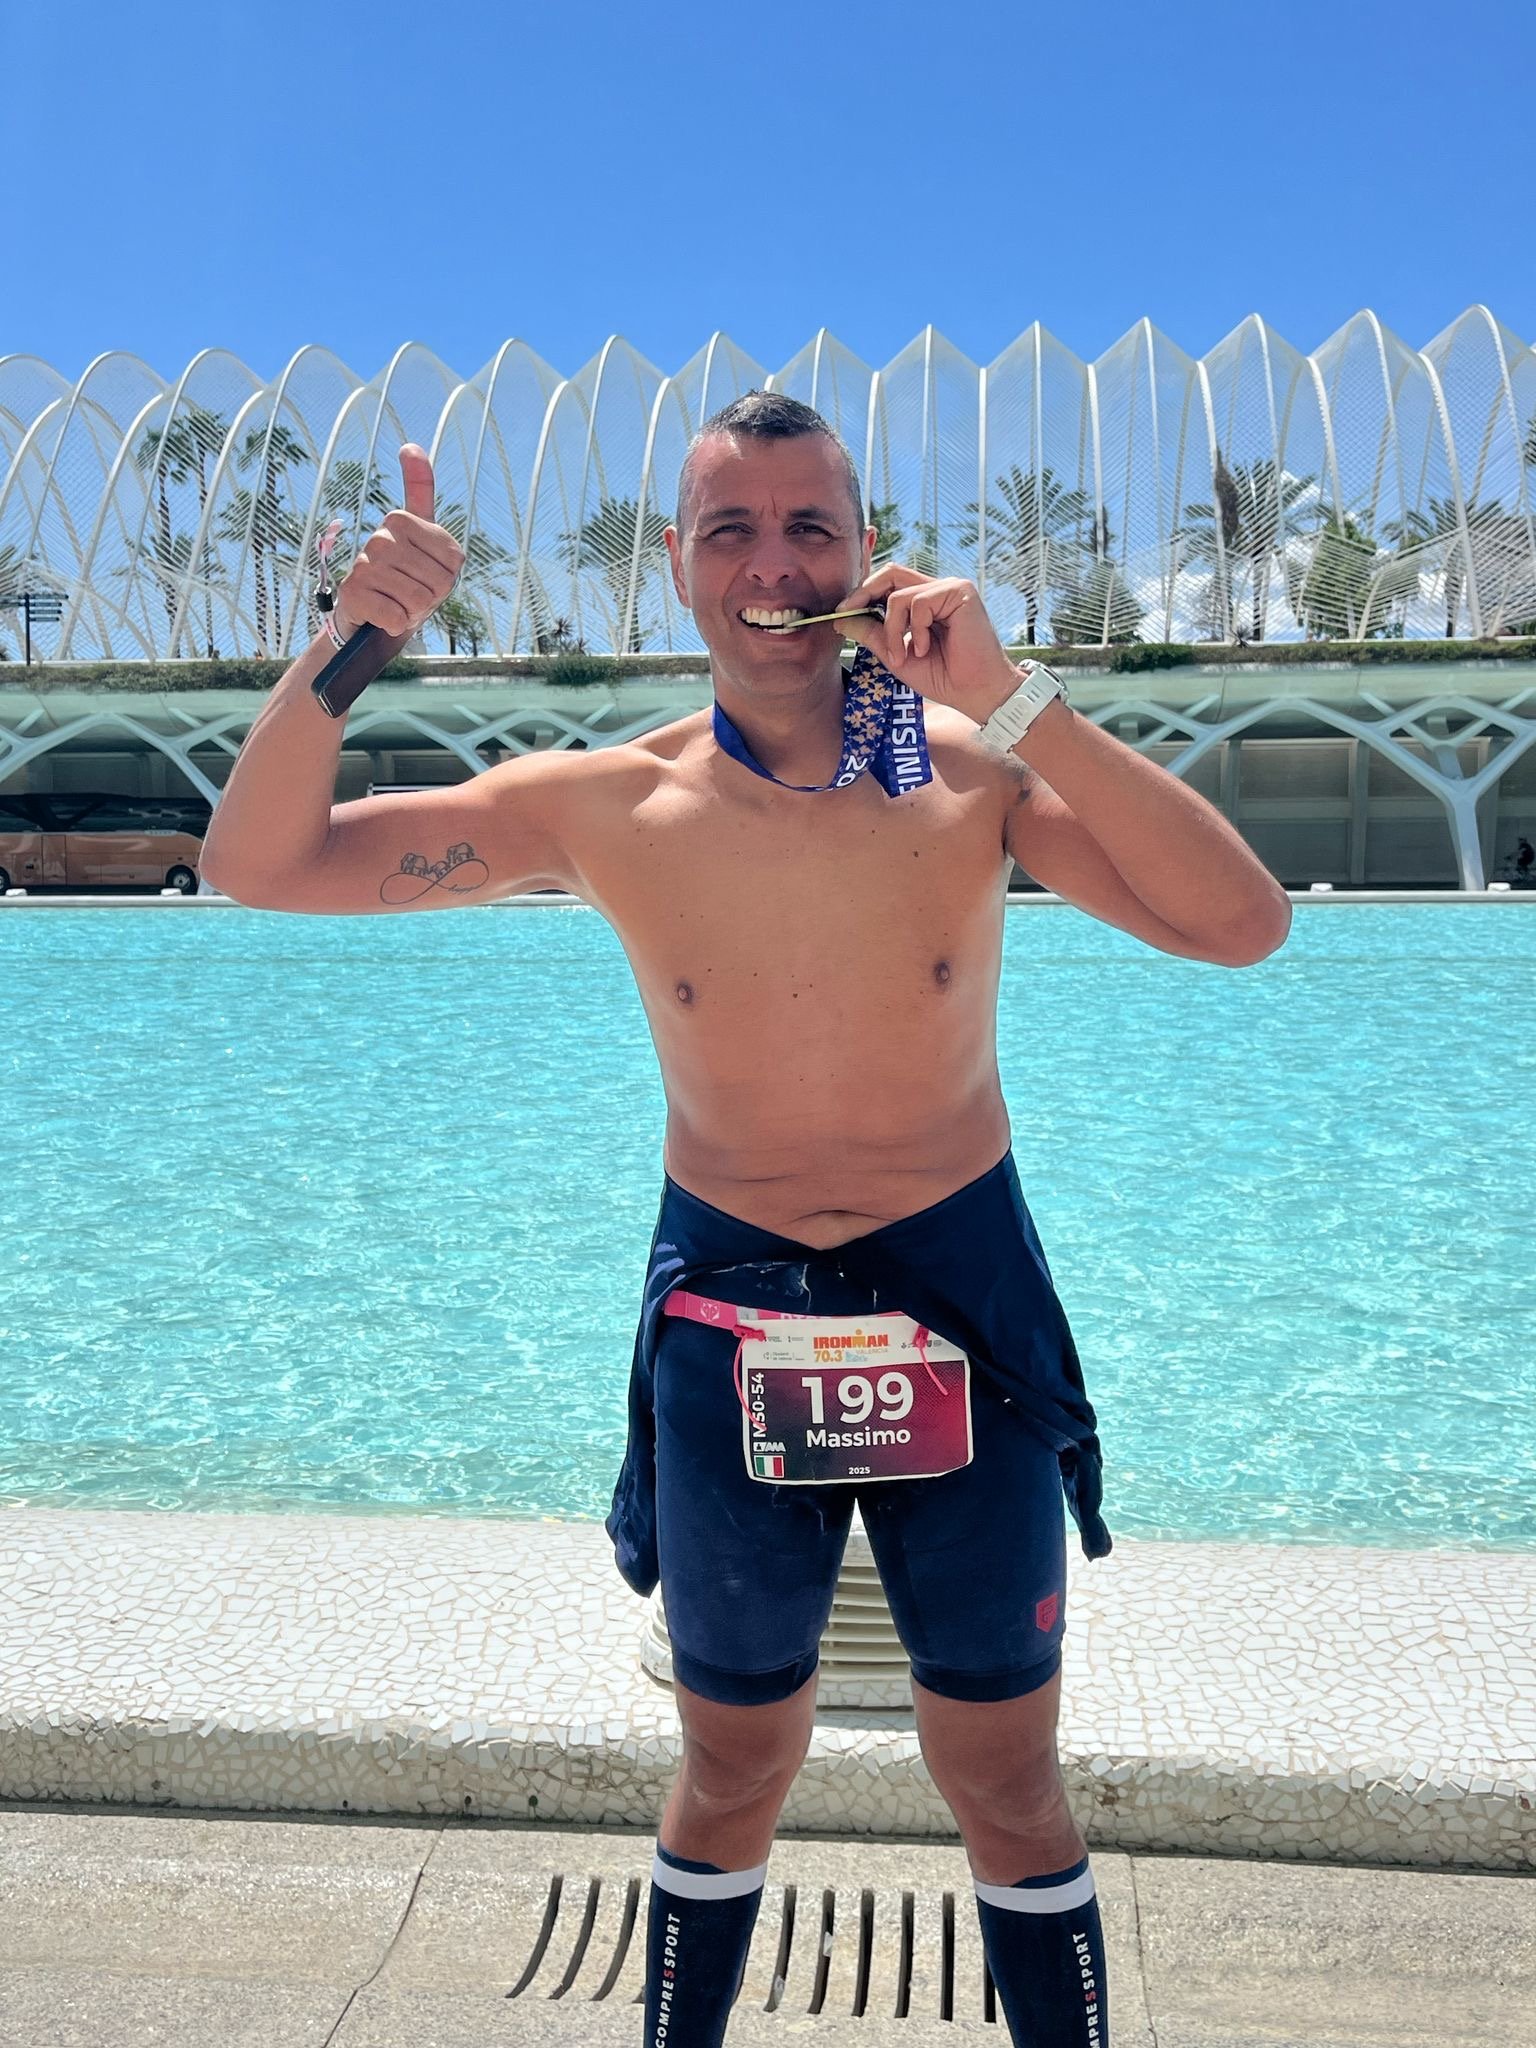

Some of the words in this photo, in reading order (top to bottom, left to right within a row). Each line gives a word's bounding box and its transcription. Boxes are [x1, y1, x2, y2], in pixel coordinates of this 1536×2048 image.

[813, 1329, 889, 1349] IRONMAN
[814, 1350, 843, 1362] 70.3
[751, 1372, 767, 1438] M50-54
[801, 1372, 914, 1425] 199
[806, 1426, 911, 1448] Massimo
[848, 1466, 871, 1475] 2025
[655, 1913, 681, 2048] COMPRESSPORT
